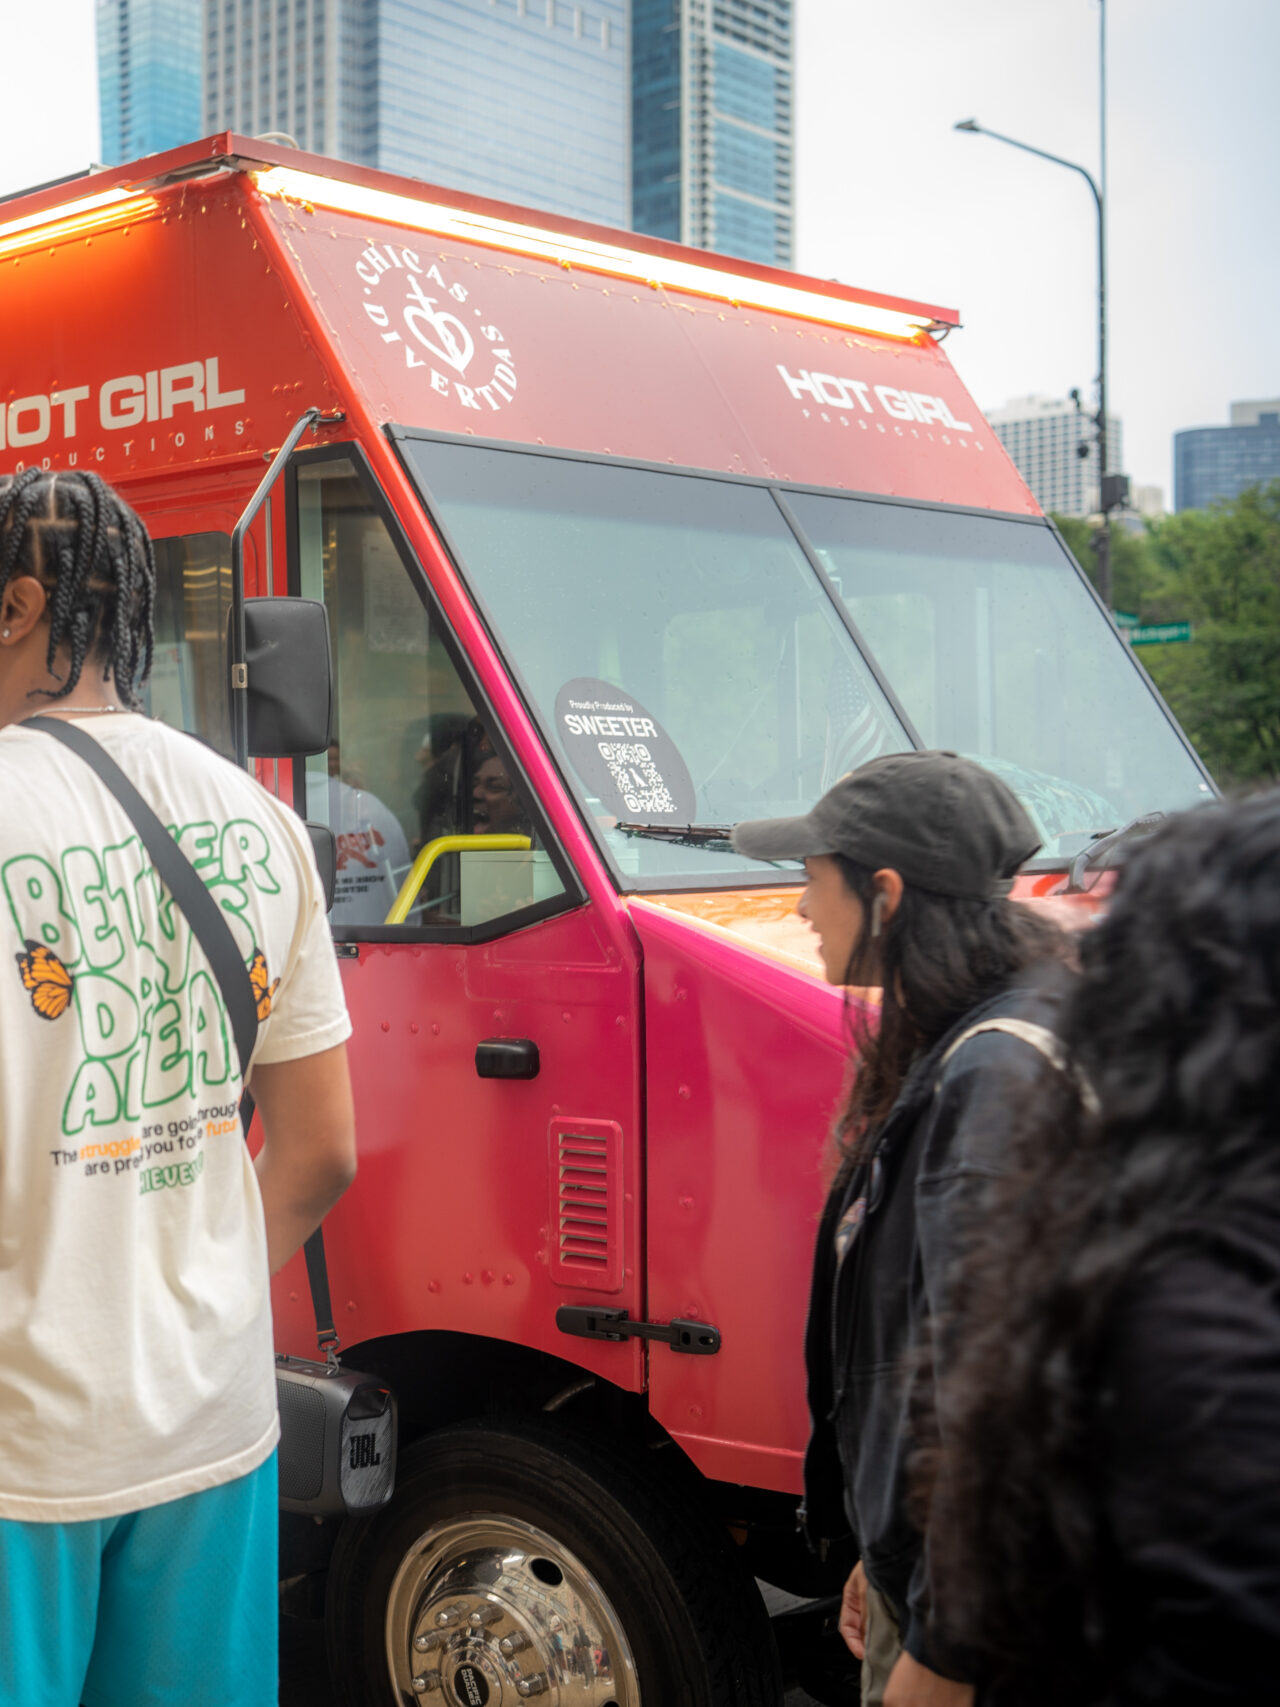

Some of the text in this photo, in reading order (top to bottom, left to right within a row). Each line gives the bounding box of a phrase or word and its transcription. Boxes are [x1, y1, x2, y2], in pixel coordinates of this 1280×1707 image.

[355, 244, 469, 303] CHICAS
[362, 301, 517, 411] DIVERTIDAS
[99, 356, 246, 430] GIRL
[775, 364, 974, 433] HOT GIRL
[564, 713, 658, 738] SWEETER
[568, 700, 634, 714] Proudly Produced by
[1, 819, 281, 971] BETER
[50, 1149, 78, 1166] The
[142, 1123, 164, 1139] are
[84, 1159, 111, 1177] are
[144, 1140, 174, 1160] you
[177, 1135, 196, 1151] fo
[350, 1433, 381, 1470] JBL
[466, 1668, 482, 1704] PACIFIC
